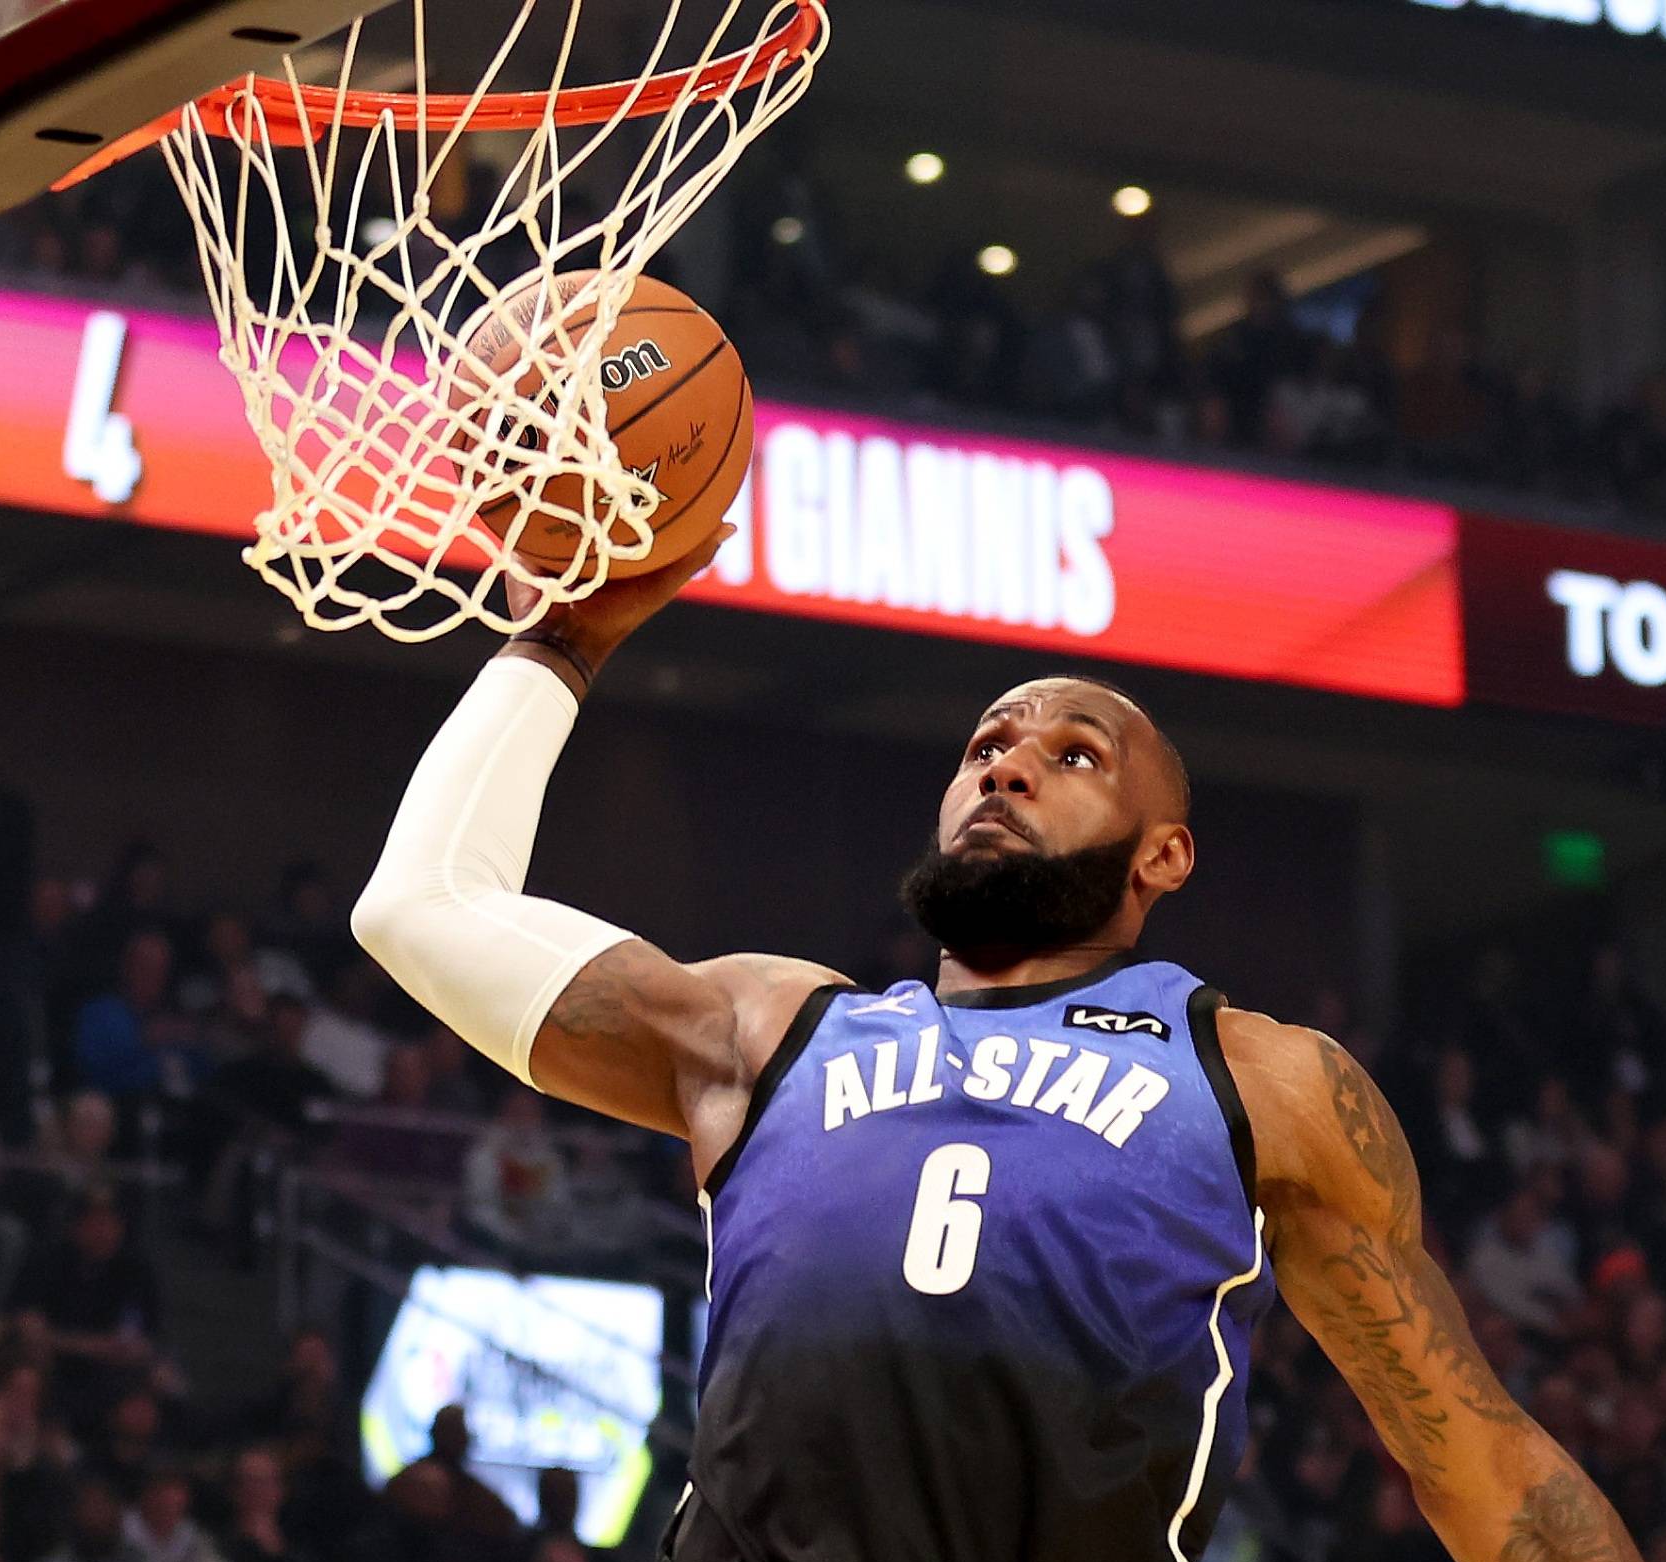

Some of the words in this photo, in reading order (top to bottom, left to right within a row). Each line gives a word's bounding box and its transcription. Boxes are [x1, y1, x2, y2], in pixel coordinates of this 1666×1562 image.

[763, 422, 1117, 636] GIANNIS
[821, 1023, 1171, 1150] ALL-STAR
[901, 1142, 993, 1296] 6
